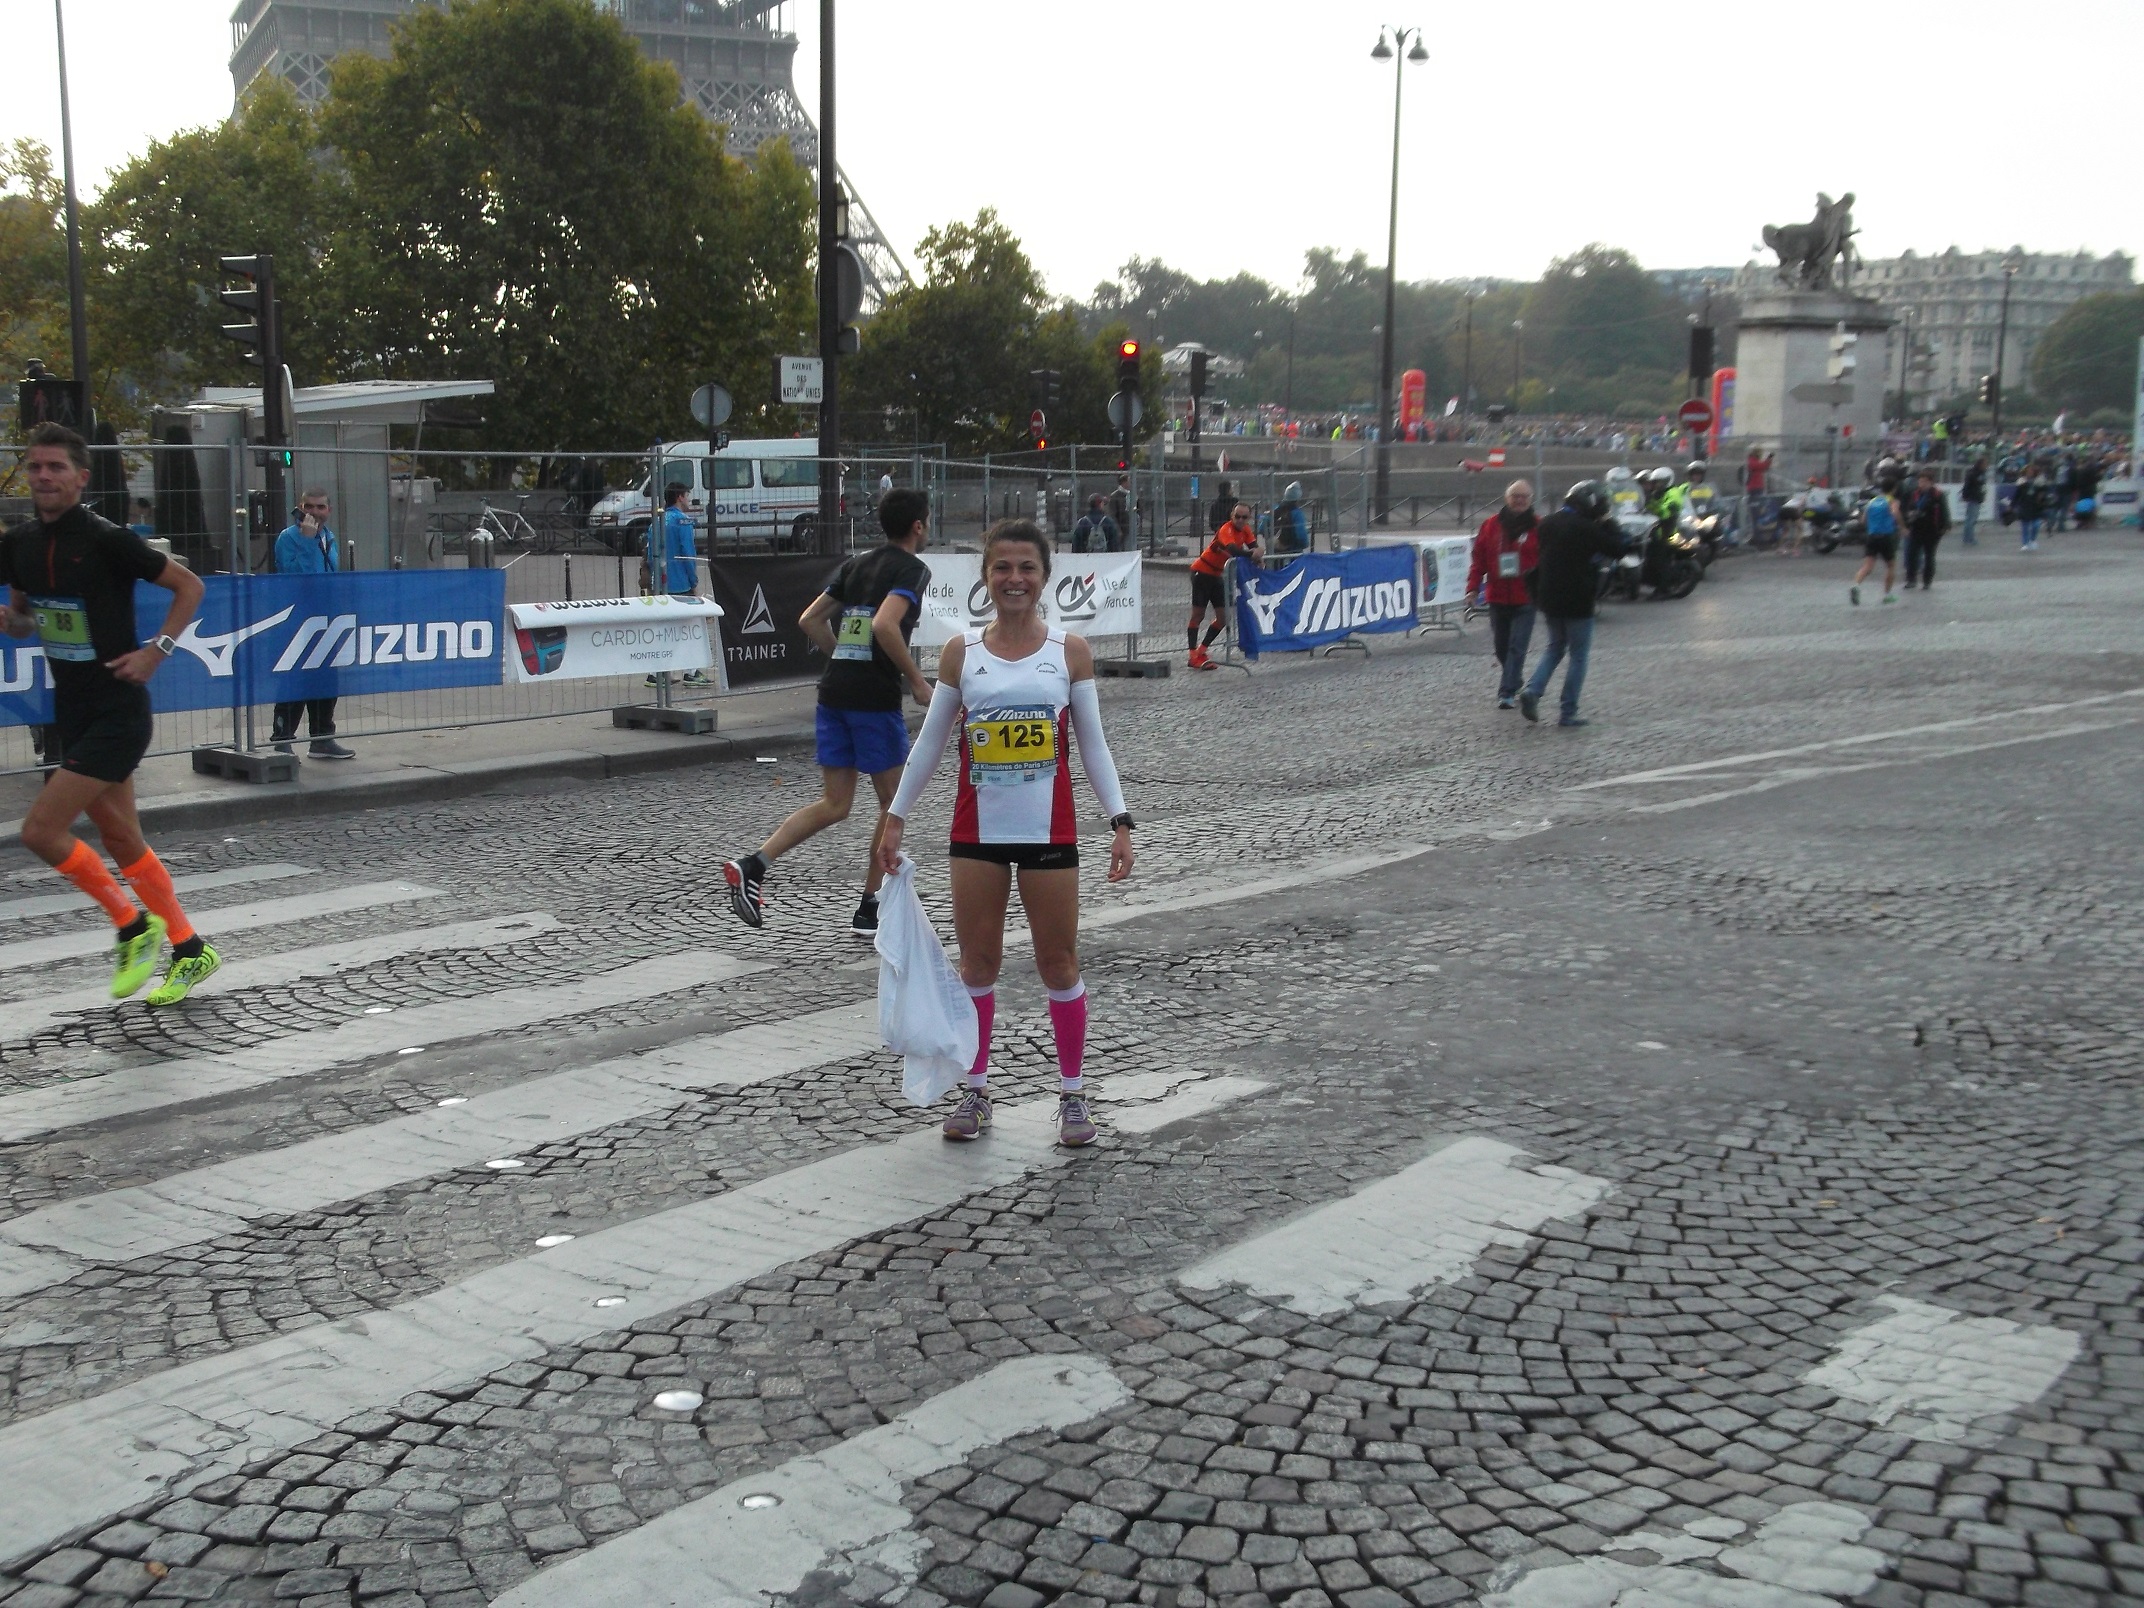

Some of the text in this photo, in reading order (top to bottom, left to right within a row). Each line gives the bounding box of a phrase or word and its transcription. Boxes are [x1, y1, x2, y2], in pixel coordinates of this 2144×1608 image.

[792, 362, 812, 370] AVENUE
[796, 375, 807, 383] DES
[805, 387, 820, 398] UNIES
[1119, 575, 1128, 590] de
[941, 582, 954, 598] de
[928, 603, 959, 617] France
[591, 624, 702, 648] CARDIO+MUSIC
[630, 651, 673, 661] MONTRE GPS
[727, 643, 786, 662] TRAINER
[976, 724, 1046, 748] E 125
